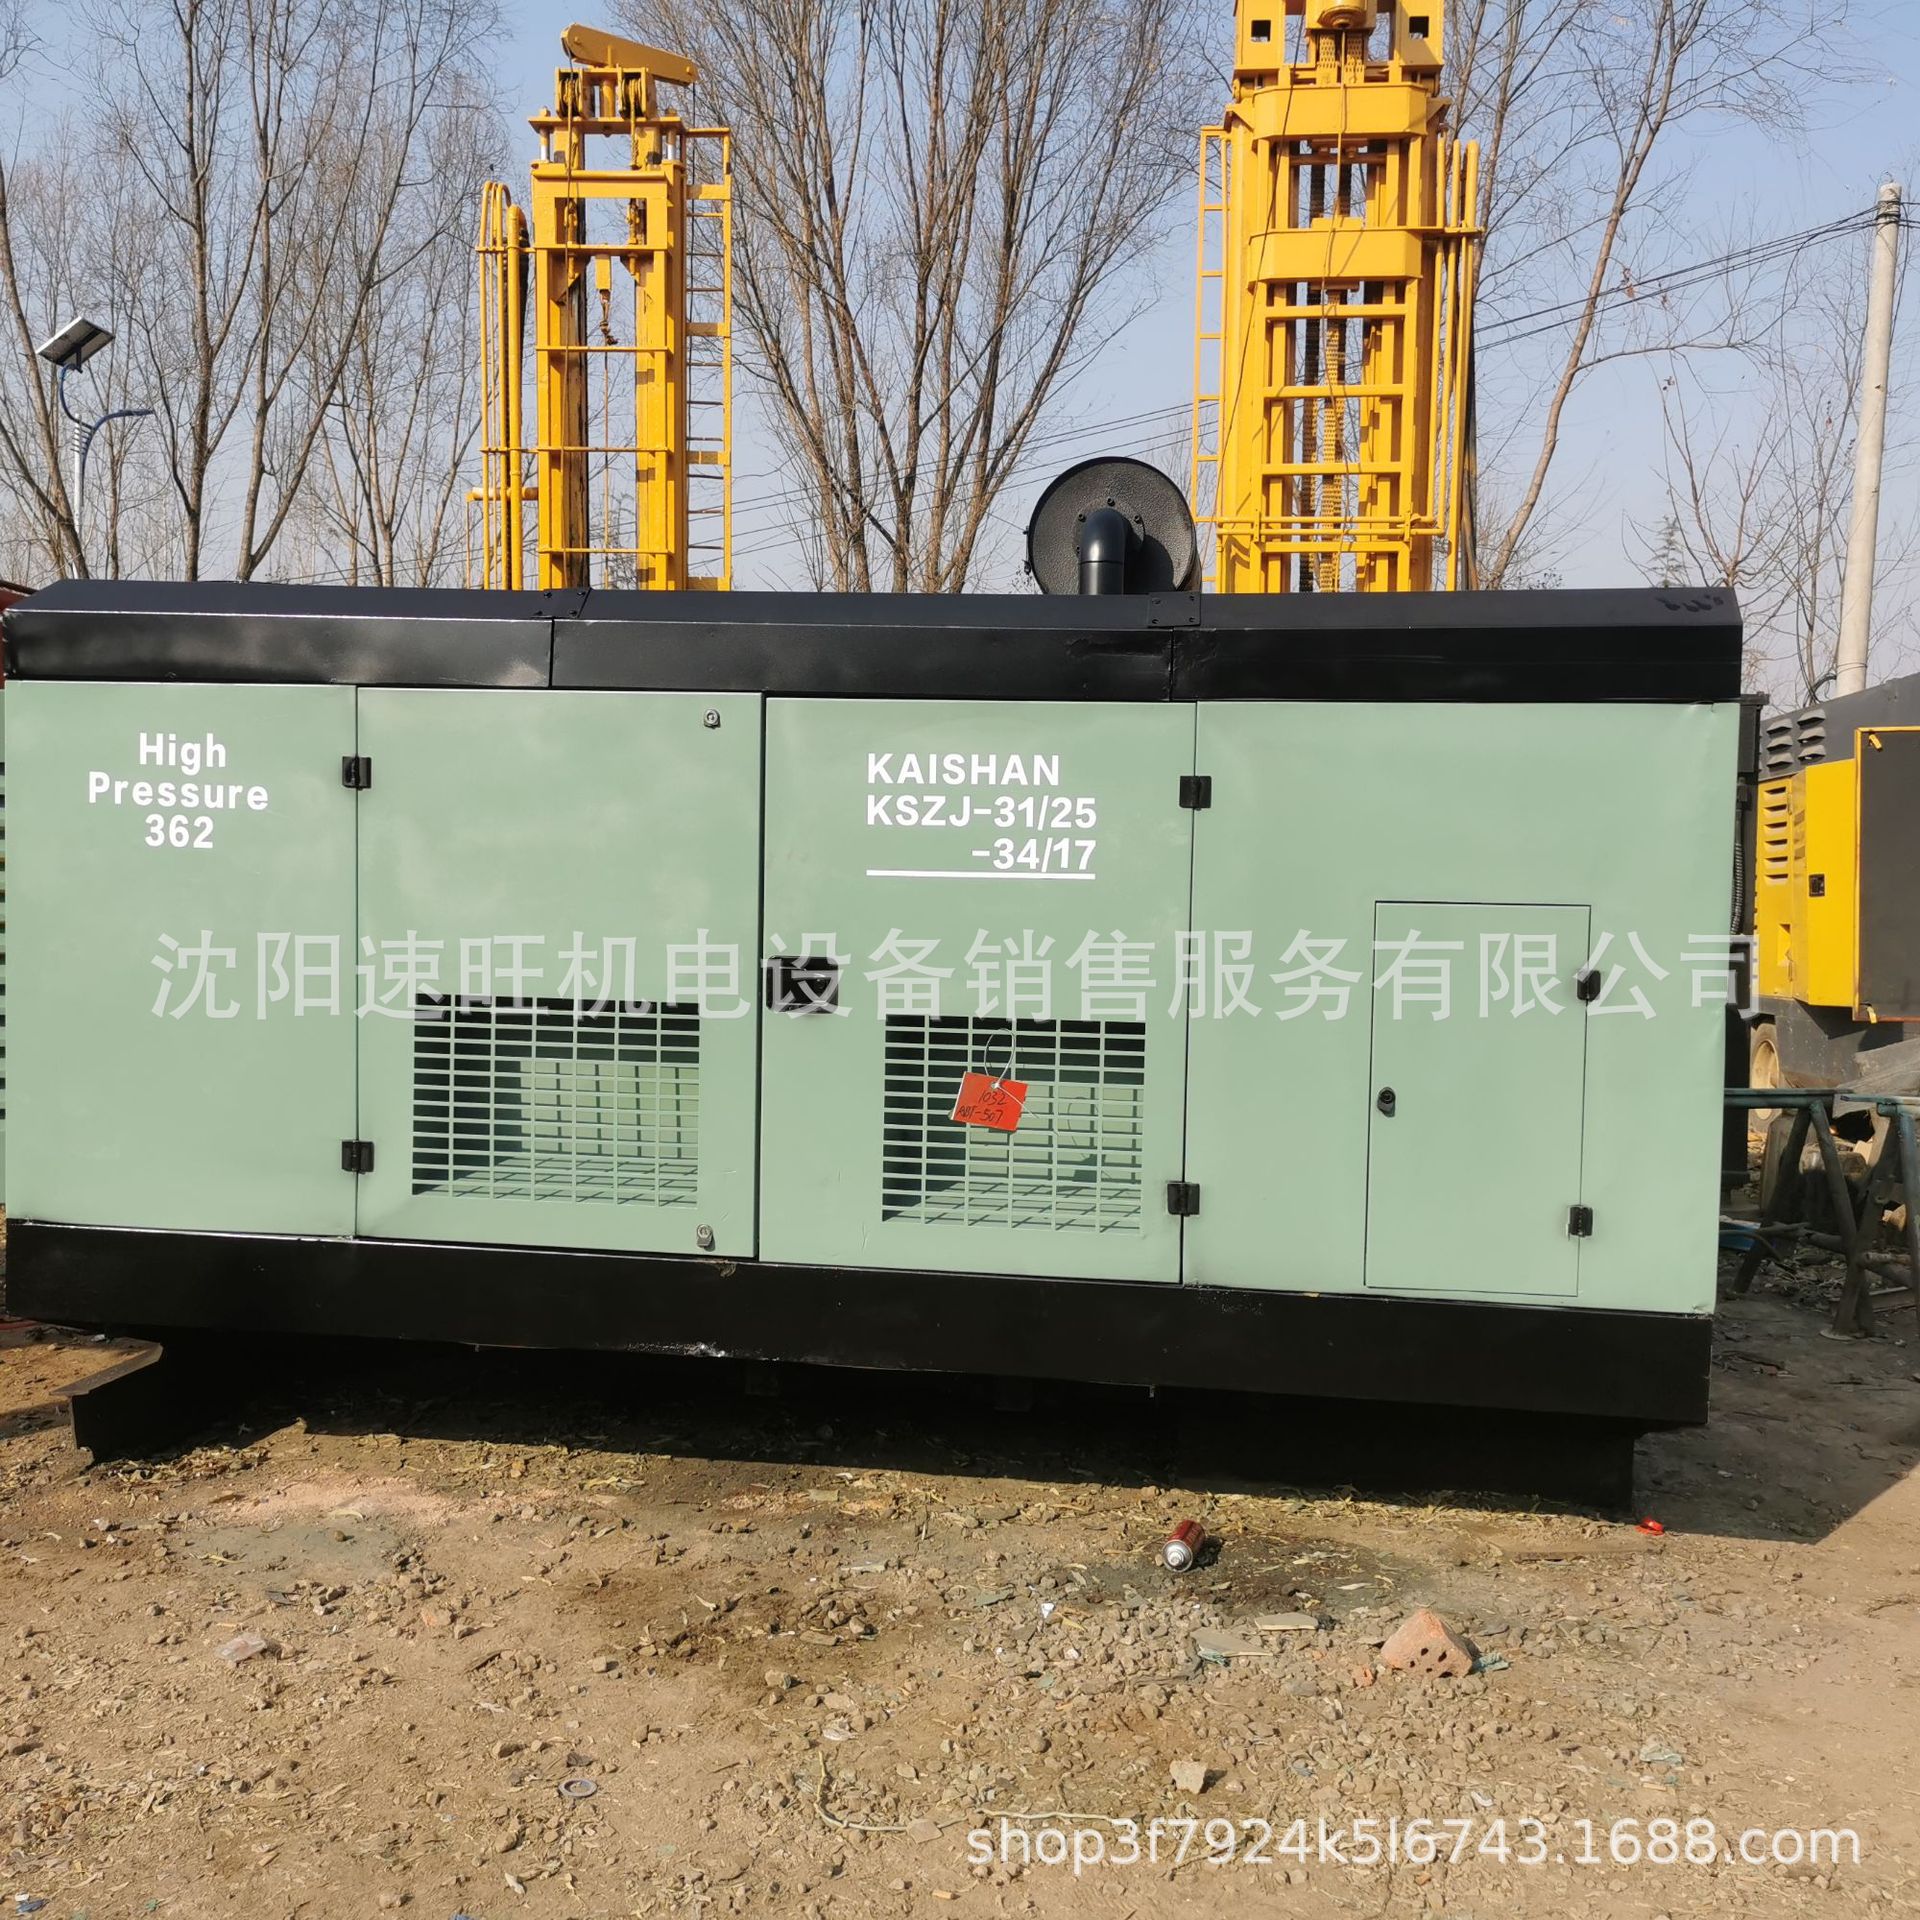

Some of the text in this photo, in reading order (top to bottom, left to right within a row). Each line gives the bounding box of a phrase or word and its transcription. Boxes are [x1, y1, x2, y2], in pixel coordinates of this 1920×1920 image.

[138, 732, 227, 776] High
[866, 752, 1060, 787] KAISHAN
[88, 770, 269, 811] Pressure
[866, 794, 1098, 831] KSZJ-31/25
[144, 813, 214, 850] 362
[971, 836, 1098, 871] -34/17
[978, 1090, 1006, 1105] 1032
